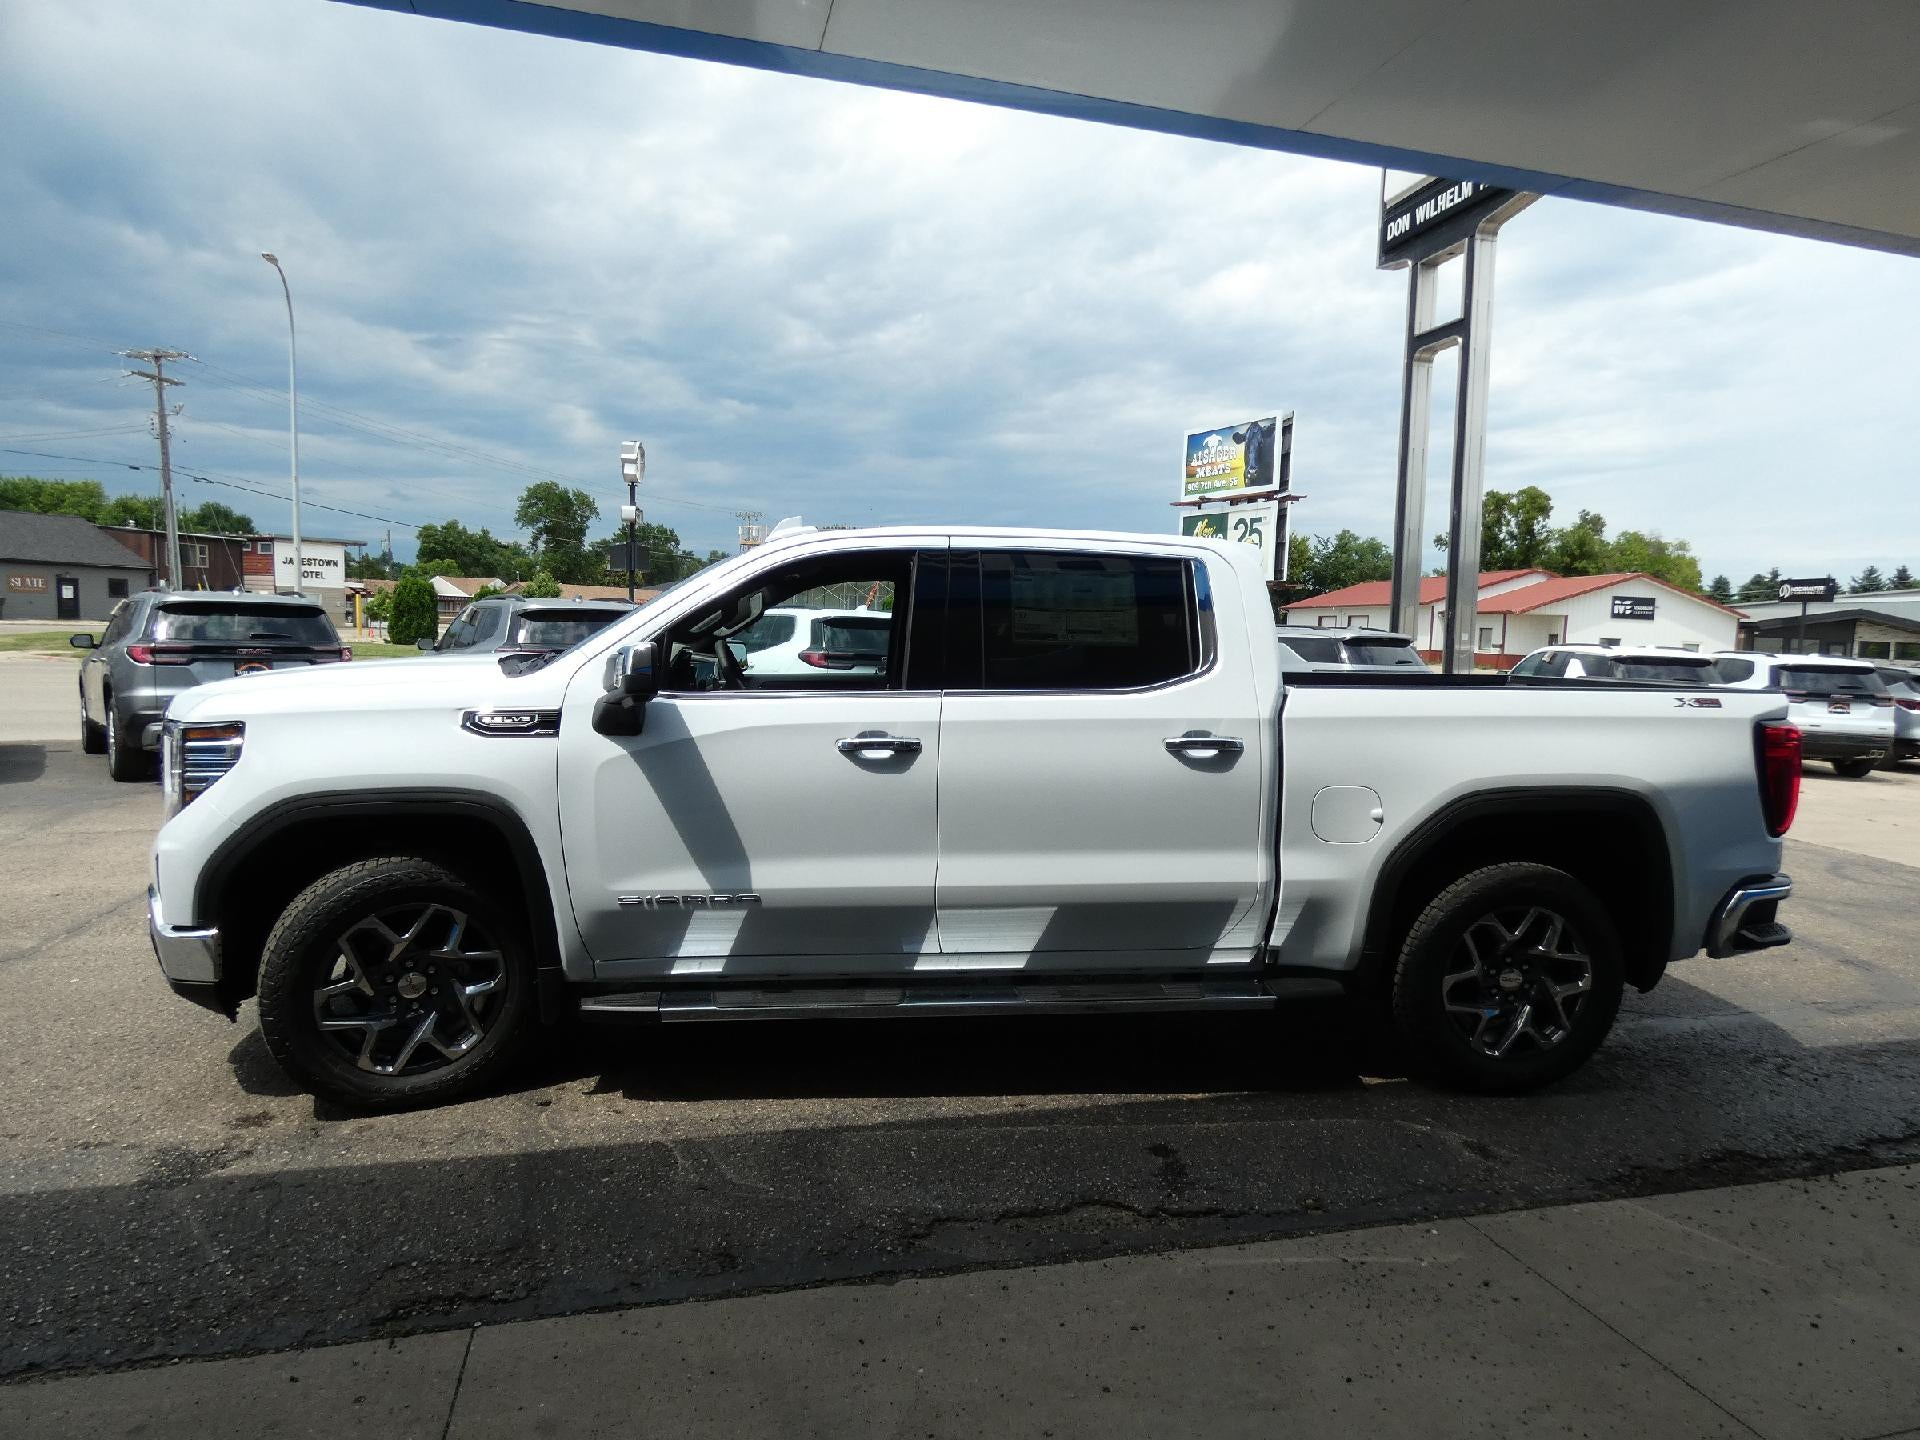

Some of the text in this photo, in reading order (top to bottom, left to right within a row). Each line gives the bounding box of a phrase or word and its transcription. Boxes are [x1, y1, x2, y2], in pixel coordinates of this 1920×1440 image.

[1387, 181, 1473, 241] DON WILHELM
[1196, 464, 1232, 479] MEATS
[282, 557, 339, 568] JAESTOWN
[301, 570, 326, 579] OTEL
[617, 893, 762, 905] SIERRA
